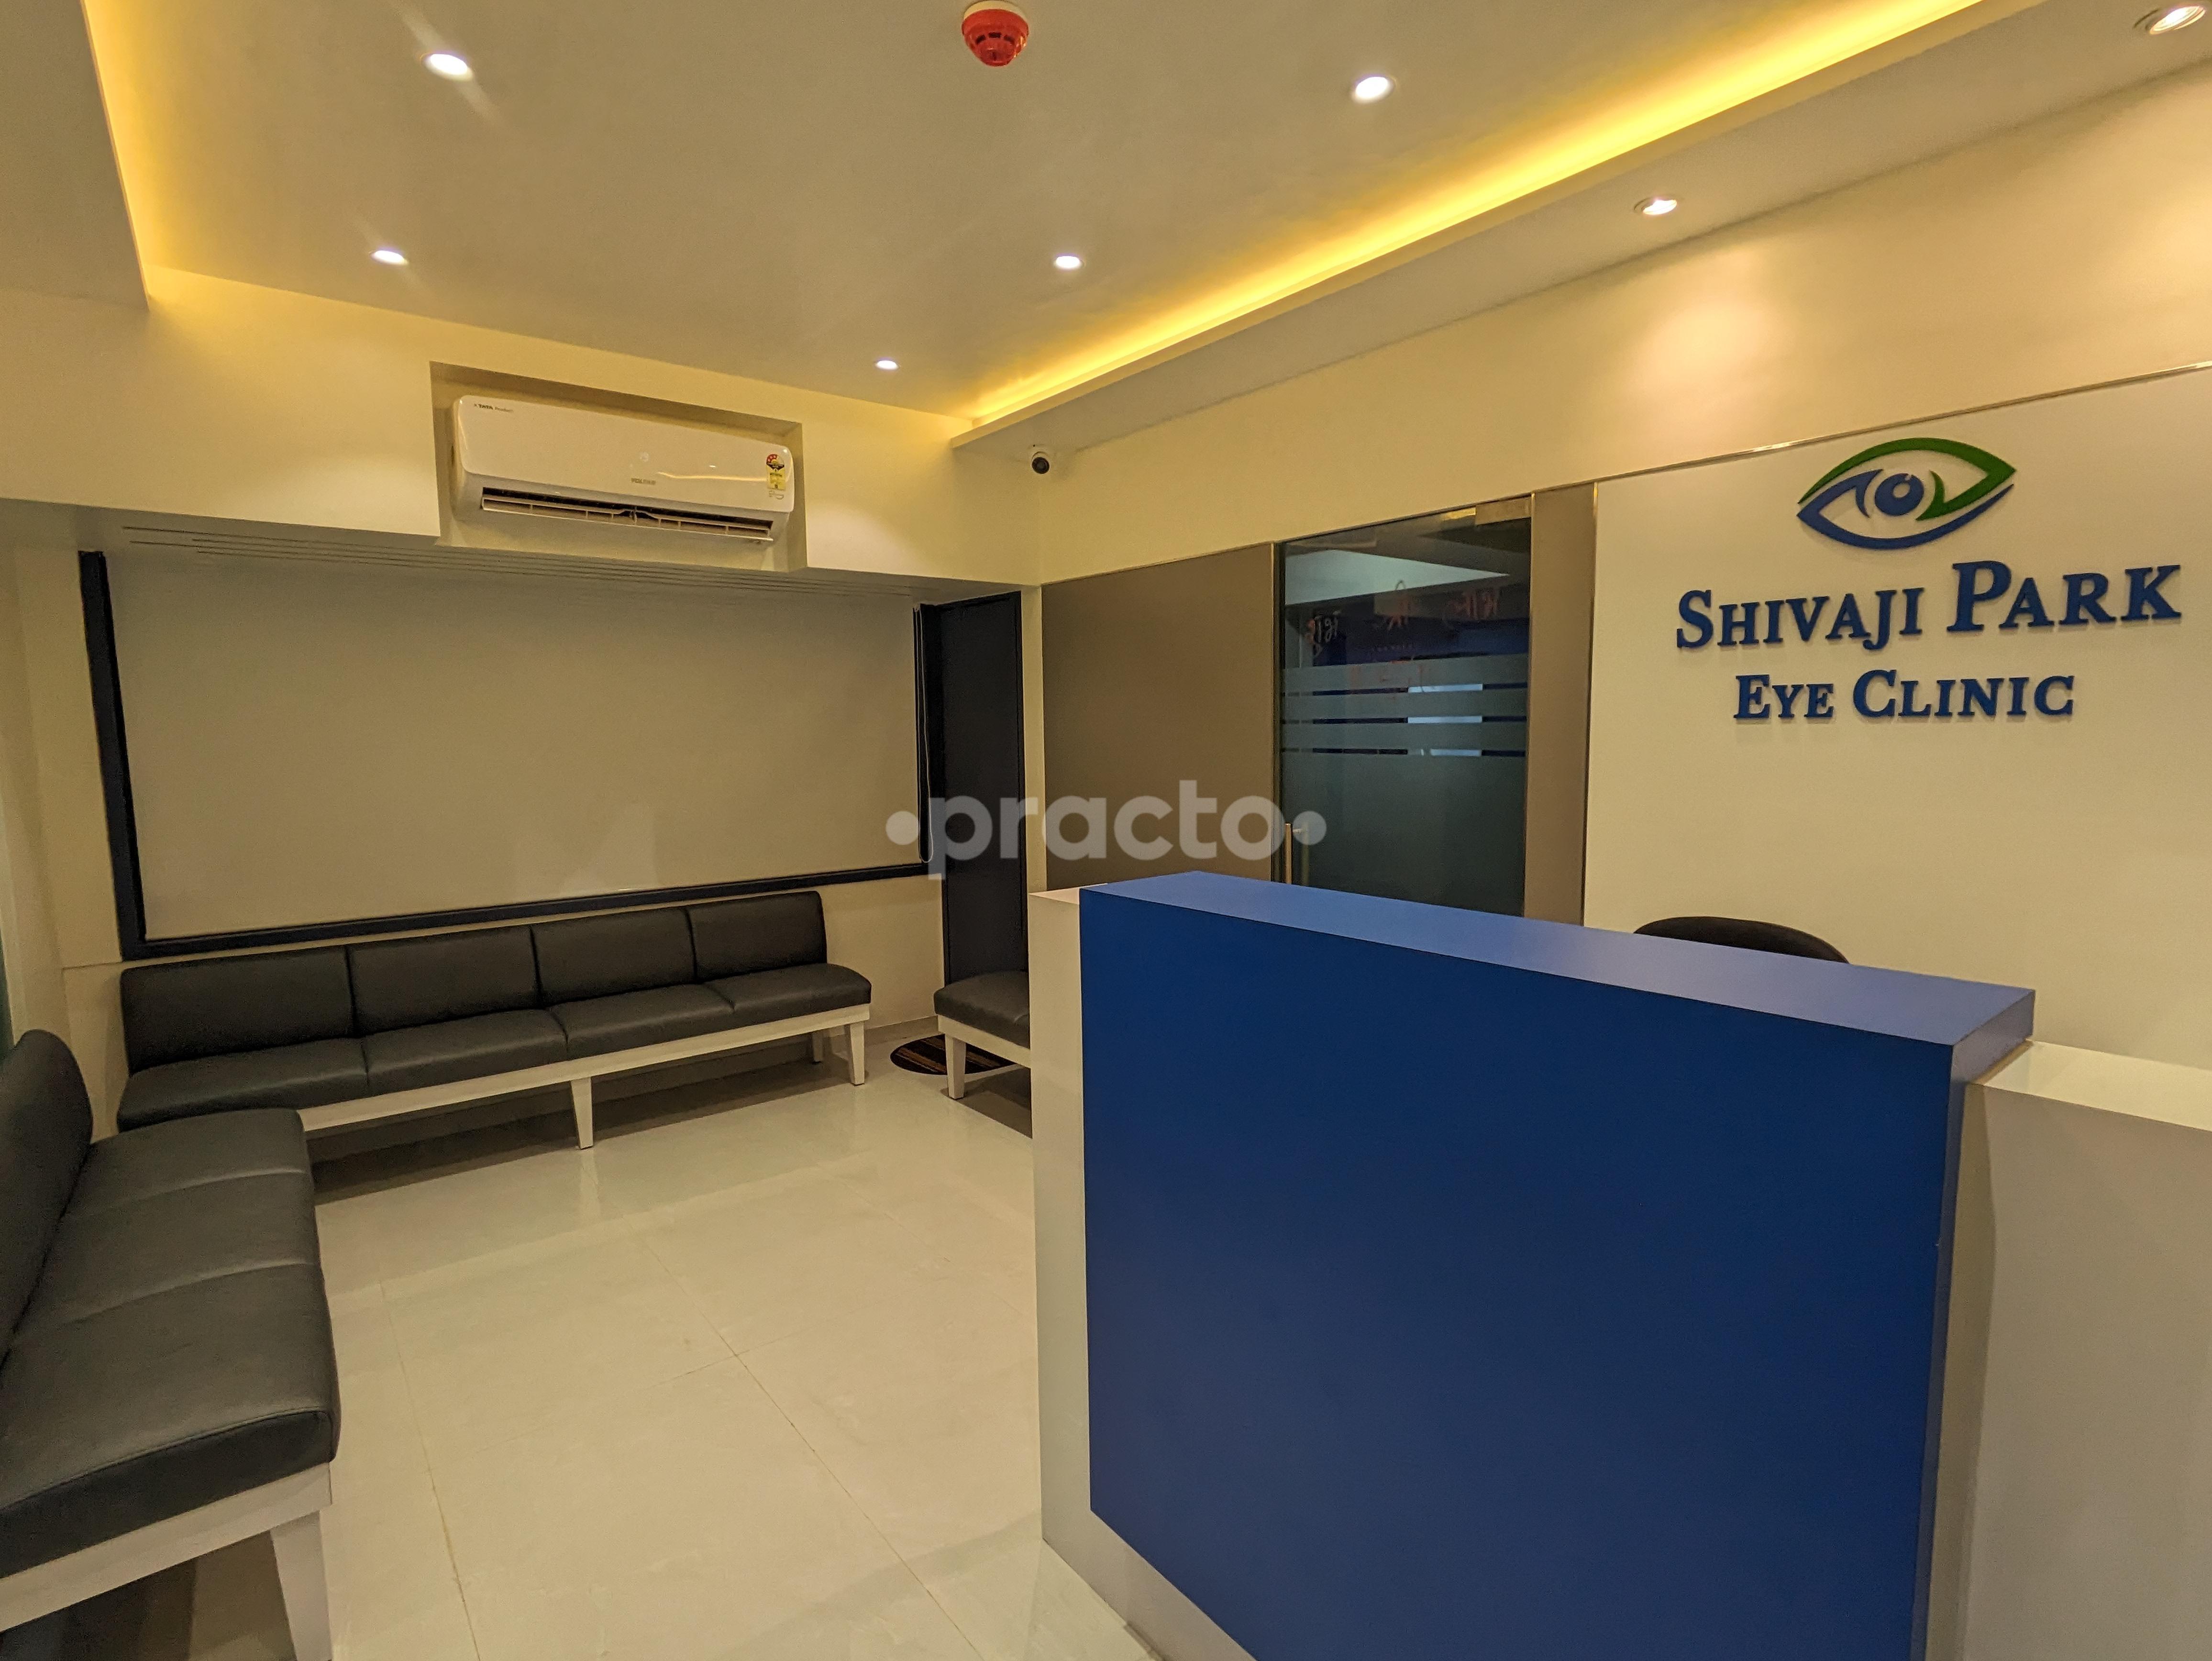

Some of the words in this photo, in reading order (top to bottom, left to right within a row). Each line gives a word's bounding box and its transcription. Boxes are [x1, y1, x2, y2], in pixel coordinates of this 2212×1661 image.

[1676, 587, 1925, 650] SHIVAJI
[1947, 560, 2182, 632] PARK
[1733, 674, 1834, 719] EYE
[1852, 669, 2075, 717] CLINIC
